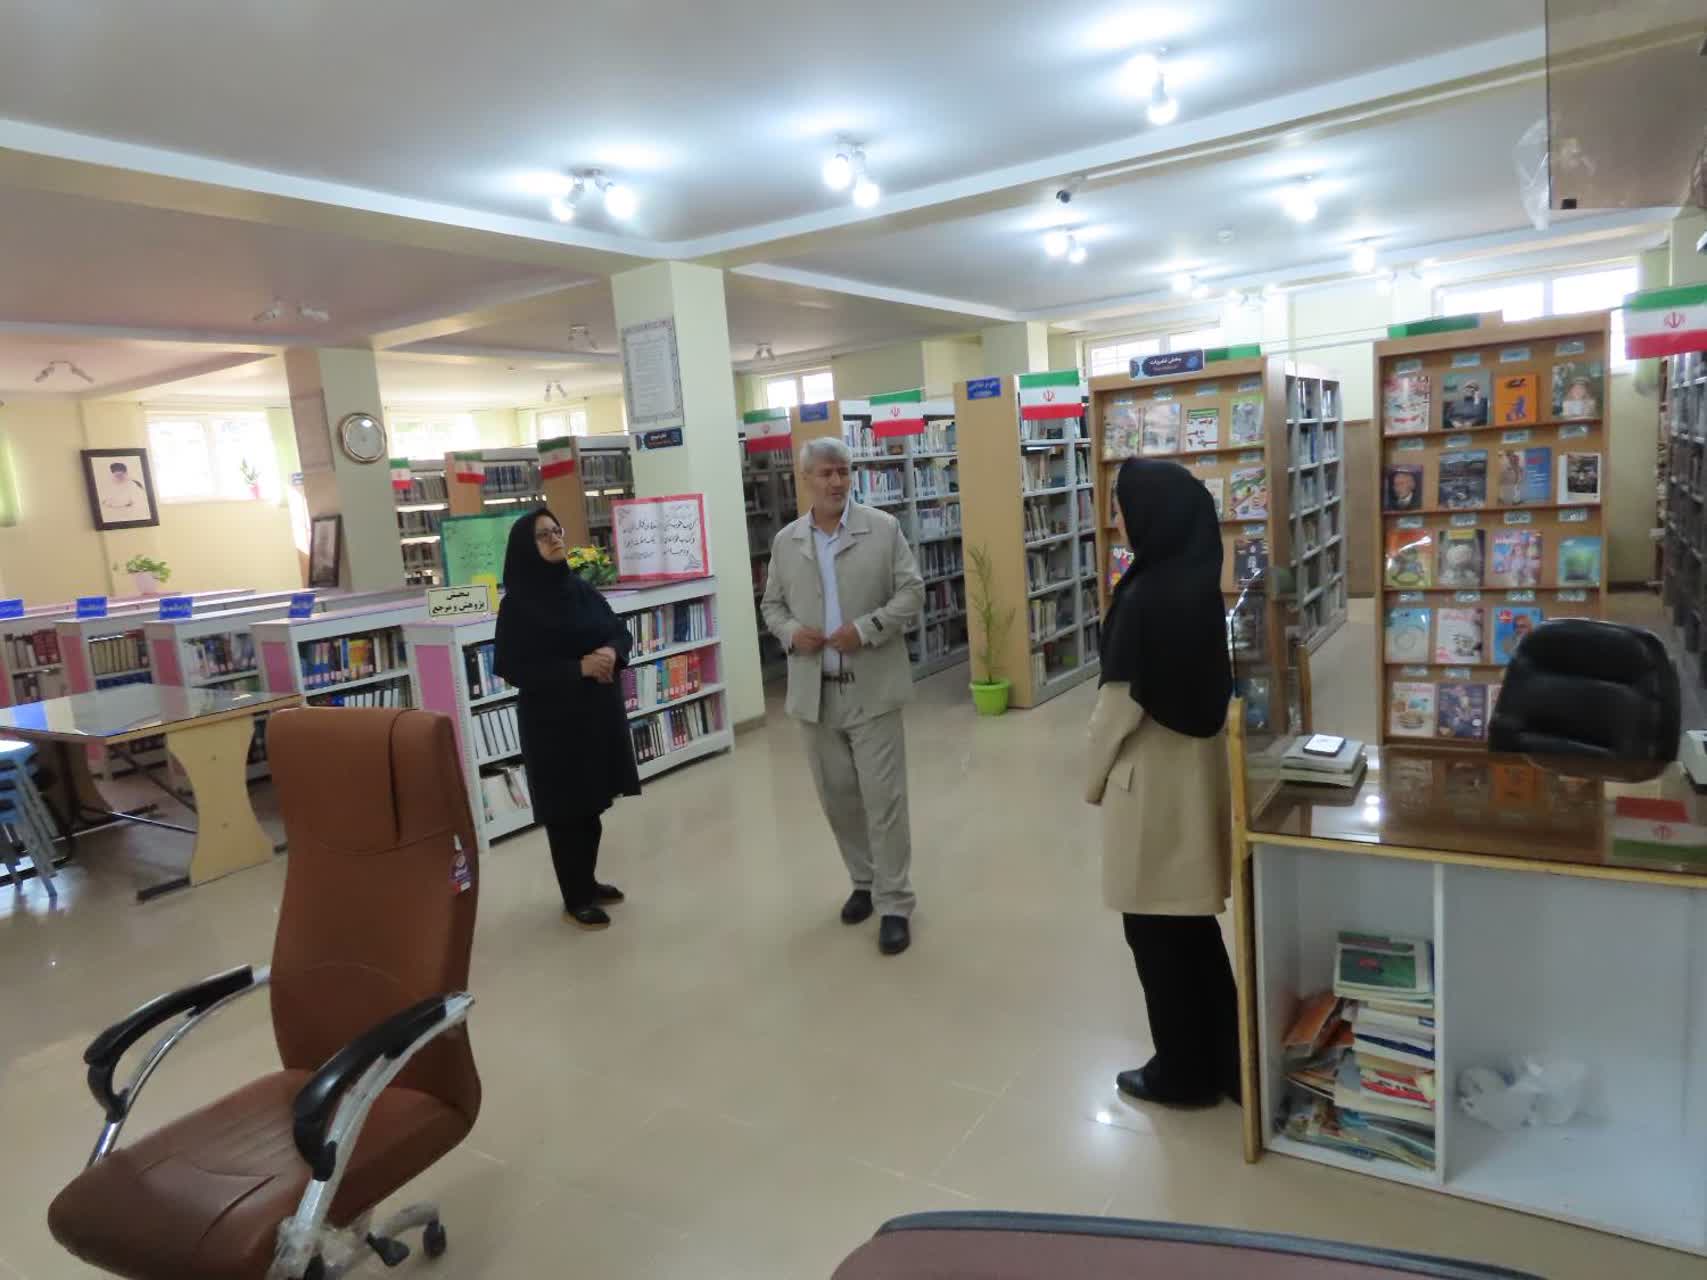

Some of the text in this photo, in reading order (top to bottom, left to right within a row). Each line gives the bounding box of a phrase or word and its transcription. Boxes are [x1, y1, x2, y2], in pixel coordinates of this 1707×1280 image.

[446, 590, 470, 600] بخش
[431, 604, 452, 613] مرجع
[459, 600, 485, 611] پژوهش
